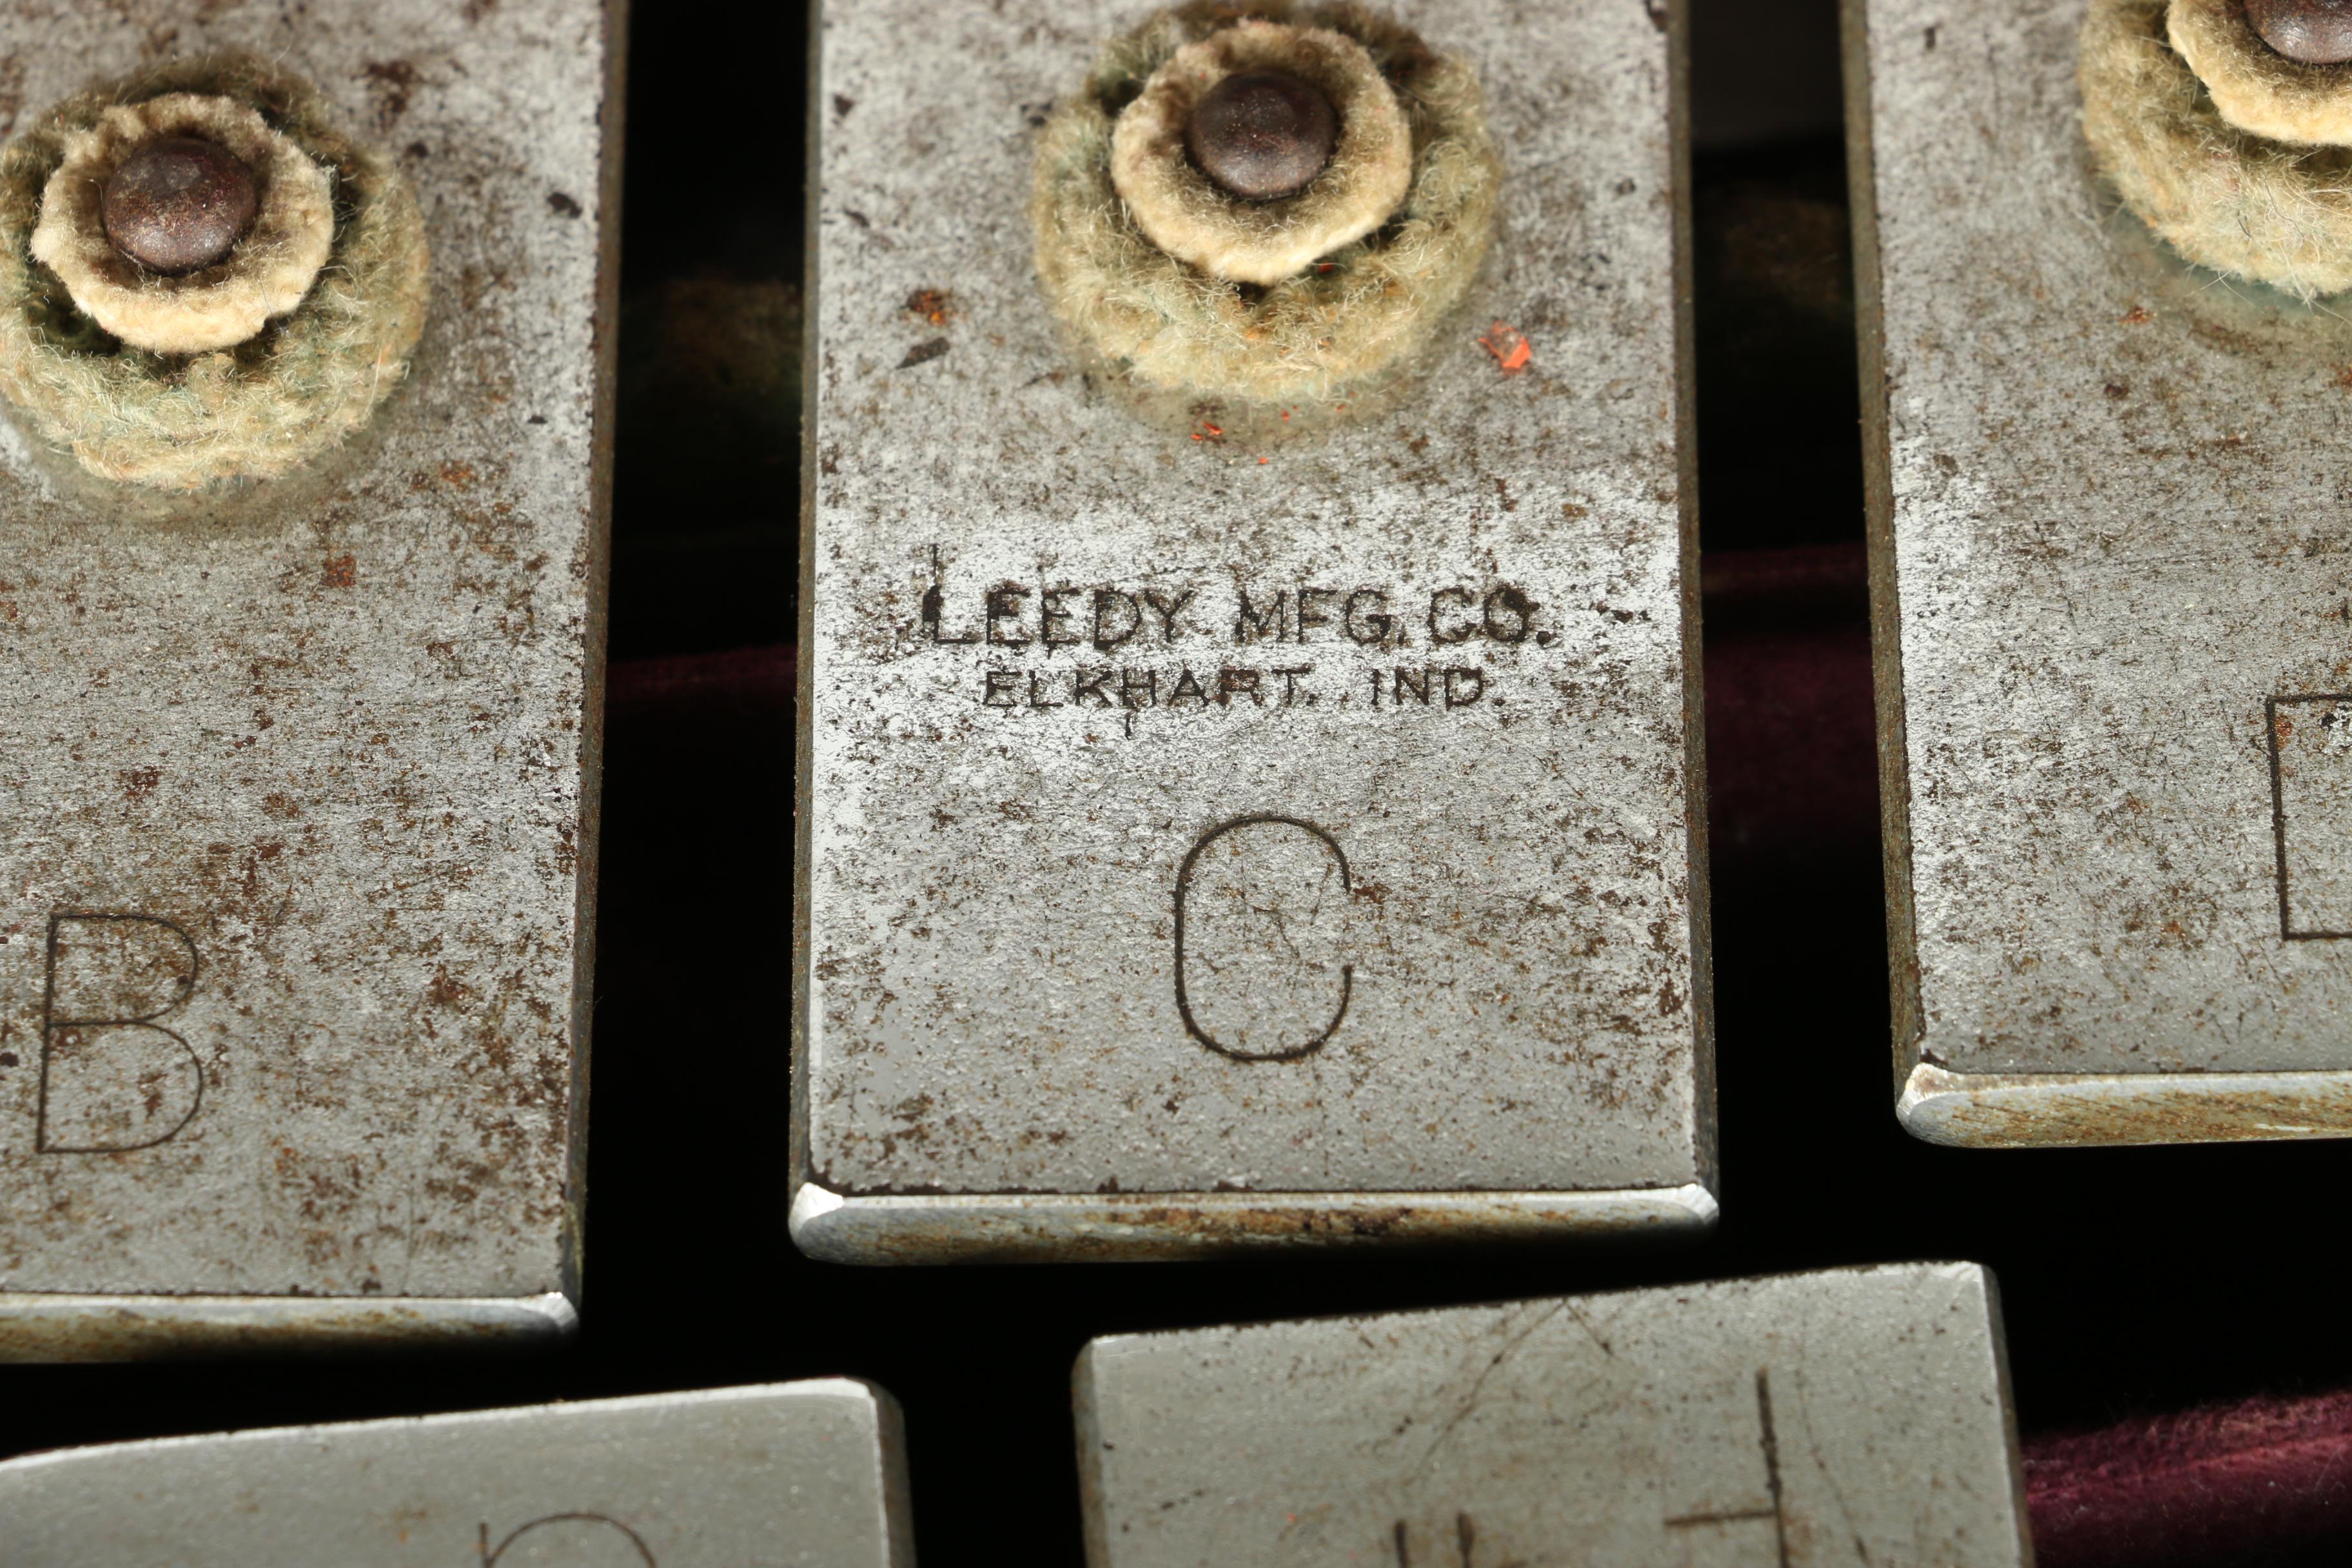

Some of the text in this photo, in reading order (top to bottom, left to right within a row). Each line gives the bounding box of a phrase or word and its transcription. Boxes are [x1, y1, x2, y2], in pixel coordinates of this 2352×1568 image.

[923, 583, 1195, 645] LEEDY
[36, 913, 202, 1153] B
[1174, 812, 1353, 1062] C
